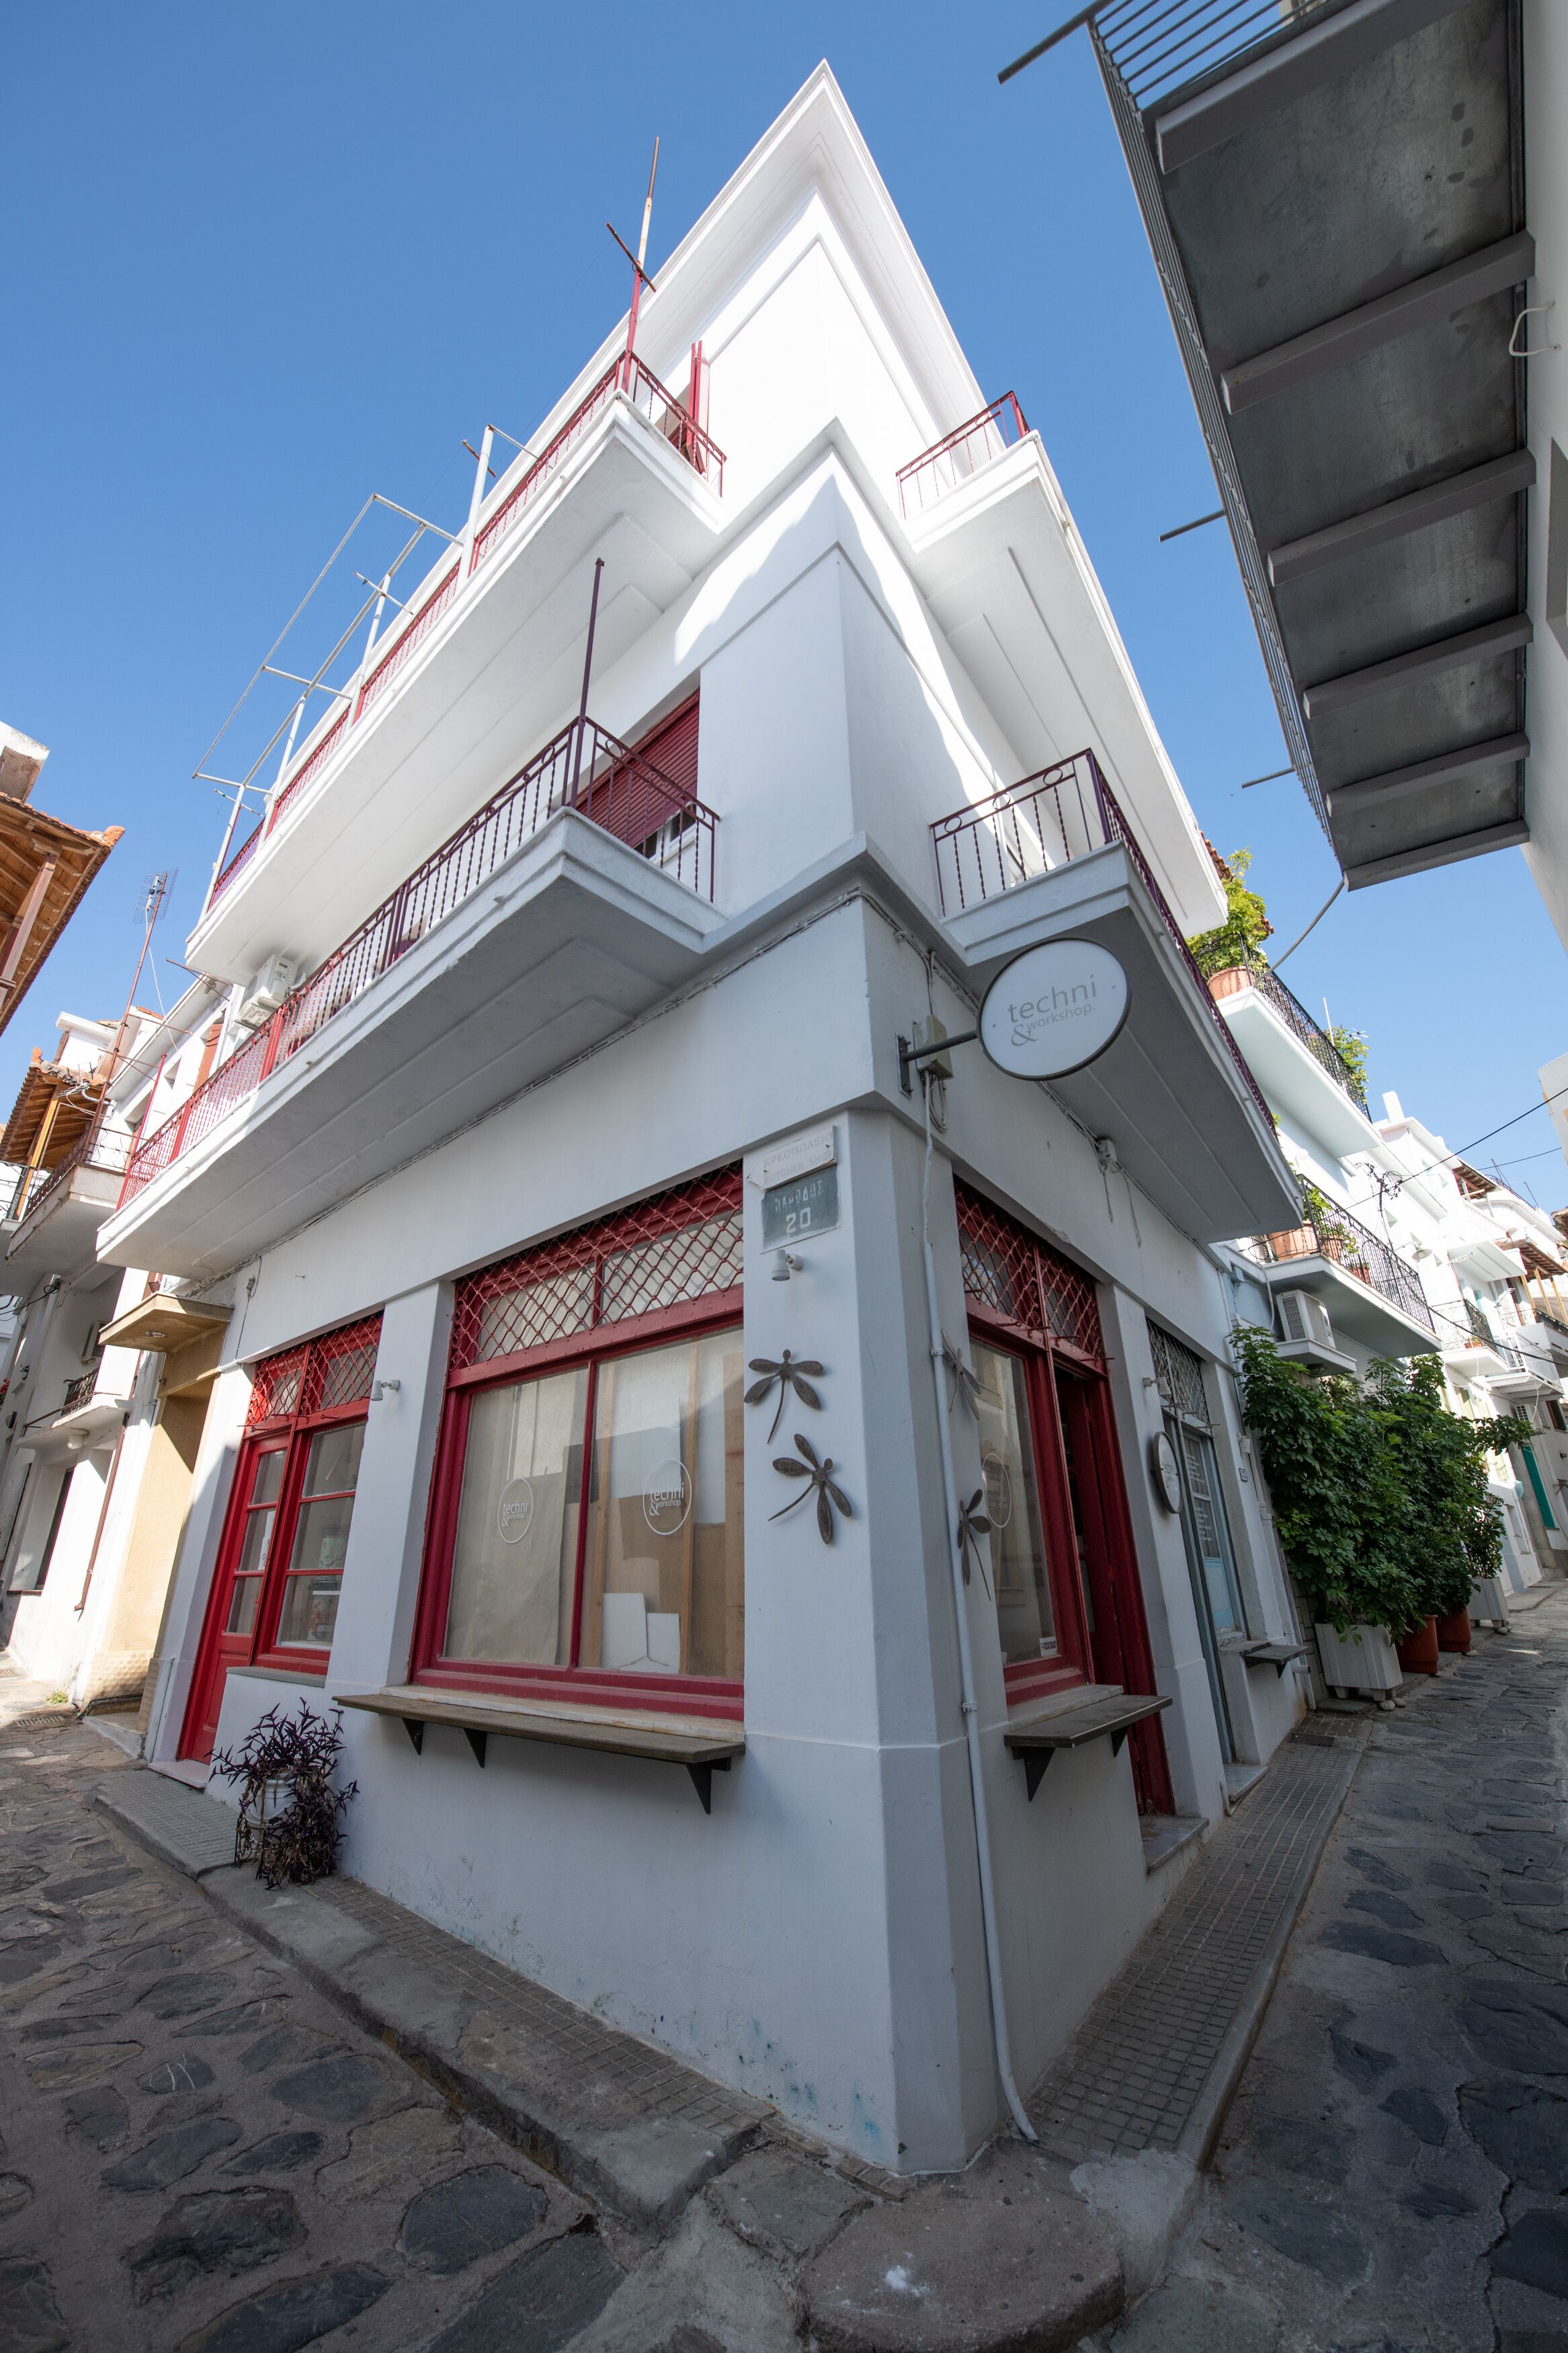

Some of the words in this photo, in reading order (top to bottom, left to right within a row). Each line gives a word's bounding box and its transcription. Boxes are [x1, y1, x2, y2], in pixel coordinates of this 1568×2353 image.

[1007, 974, 1096, 1023] techni
[1011, 1024, 1039, 1046] &
[764, 1131, 833, 1166] ΚΡΕΟΠΩΛΕΙΟ
[764, 1161, 804, 1184] BUTCHER
[786, 1207, 811, 1234] 20
[650, 1482, 684, 1501] techni
[503, 1500, 528, 1515] techni
[649, 1500, 660, 1516] &
